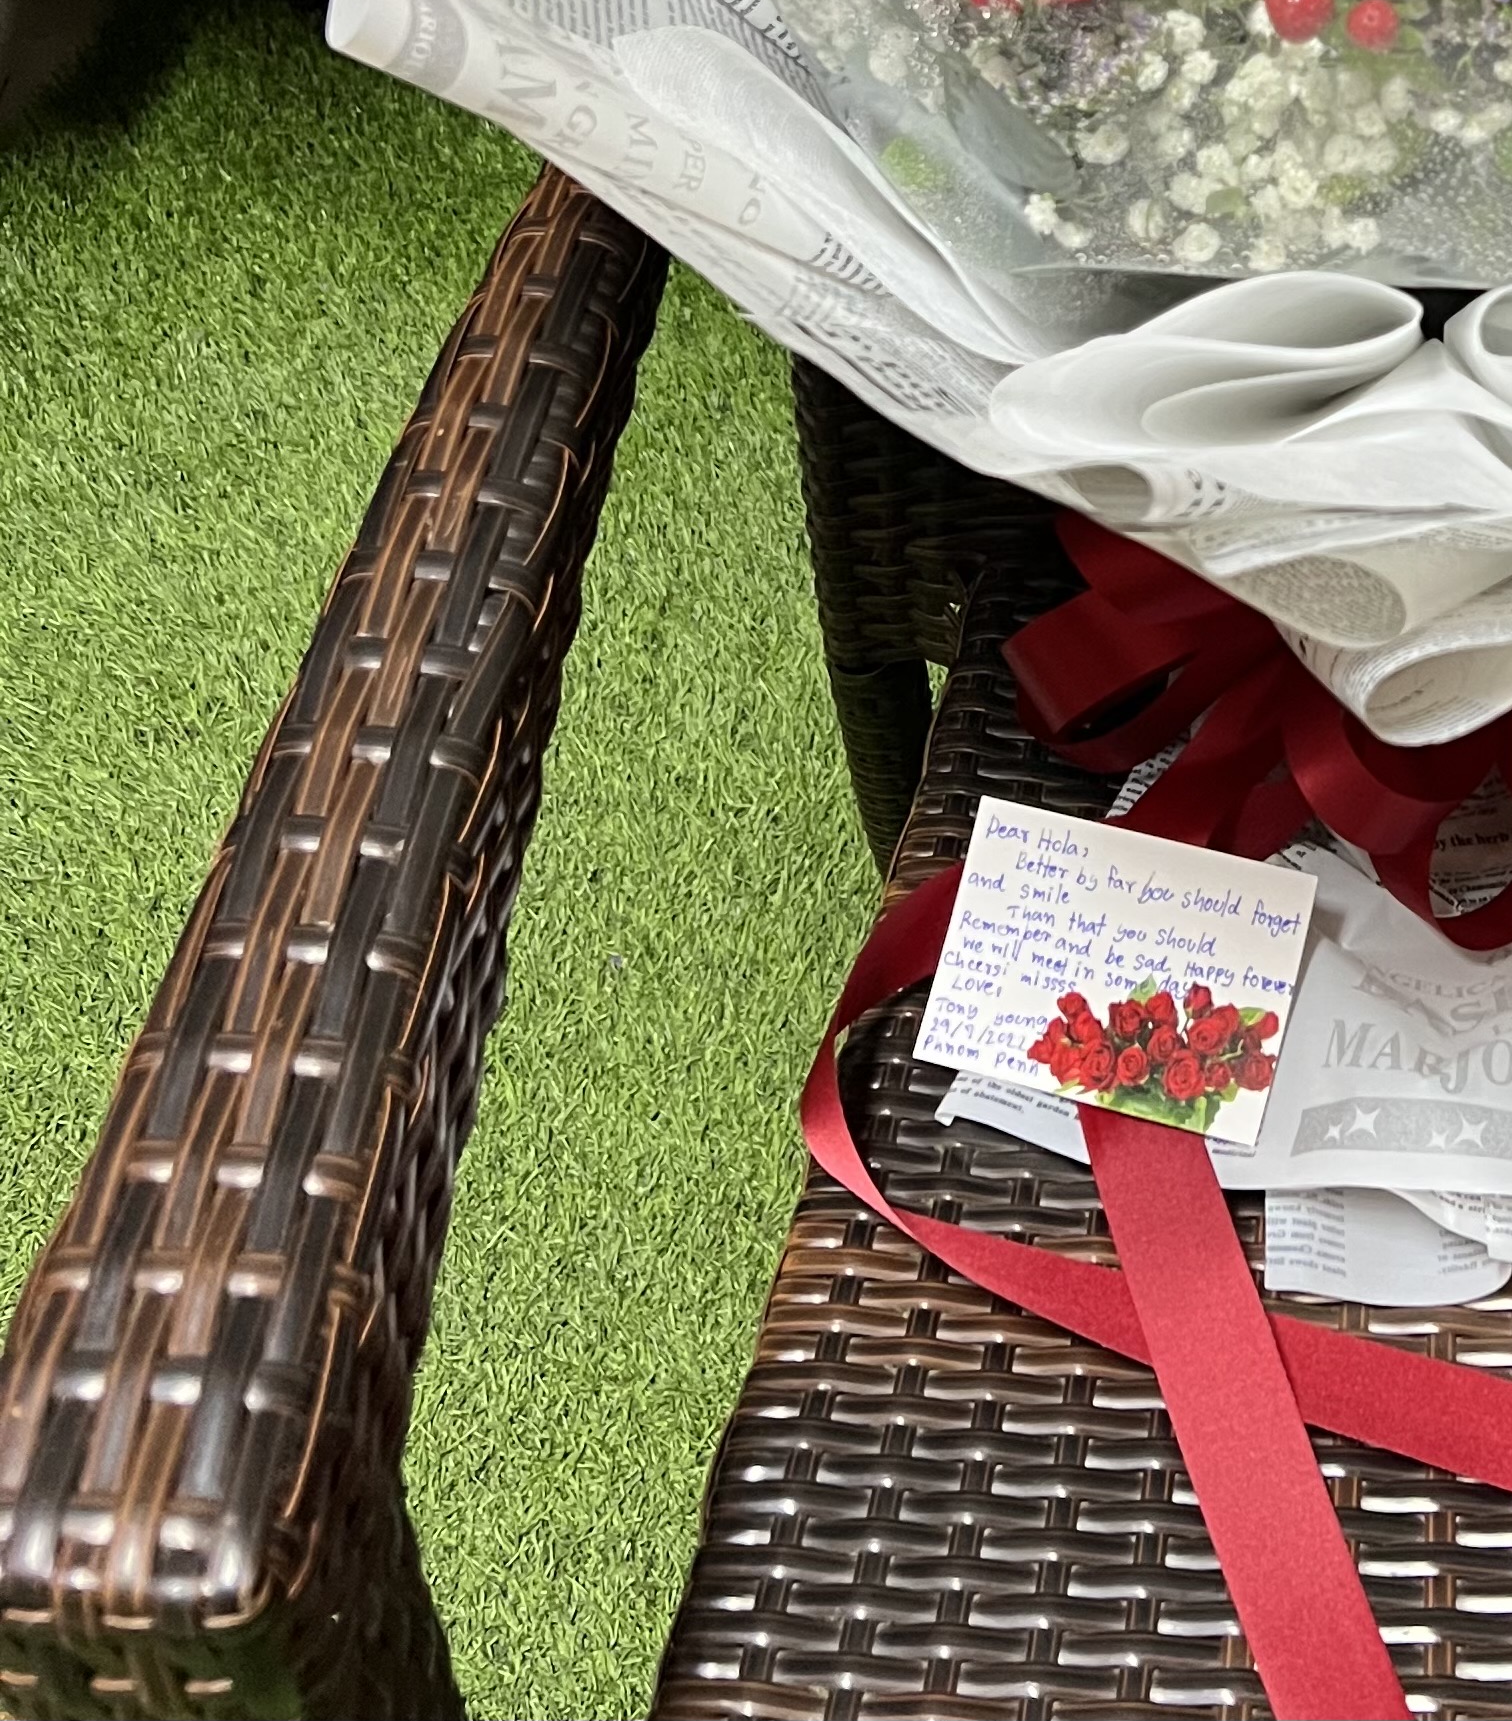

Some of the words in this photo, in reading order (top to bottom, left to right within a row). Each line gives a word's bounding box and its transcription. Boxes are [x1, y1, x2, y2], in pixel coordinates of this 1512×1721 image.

[985, 814, 1030, 844] Dear
[967, 872, 1006, 892] and
[1019, 883, 1070, 904] smile
[1015, 851, 1069, 879] Better
[1181, 887, 1242, 918] should
[1250, 898, 1302, 938] forget
[1006, 905, 1055, 928] Than
[1068, 911, 1107, 937] that
[1112, 925, 1147, 943] you
[1154, 926, 1217, 957] should
[1054, 937, 1093, 958] and
[1104, 944, 1124, 968] be
[1183, 961, 1235, 988] Happy
[934, 996, 978, 1020] Tony
